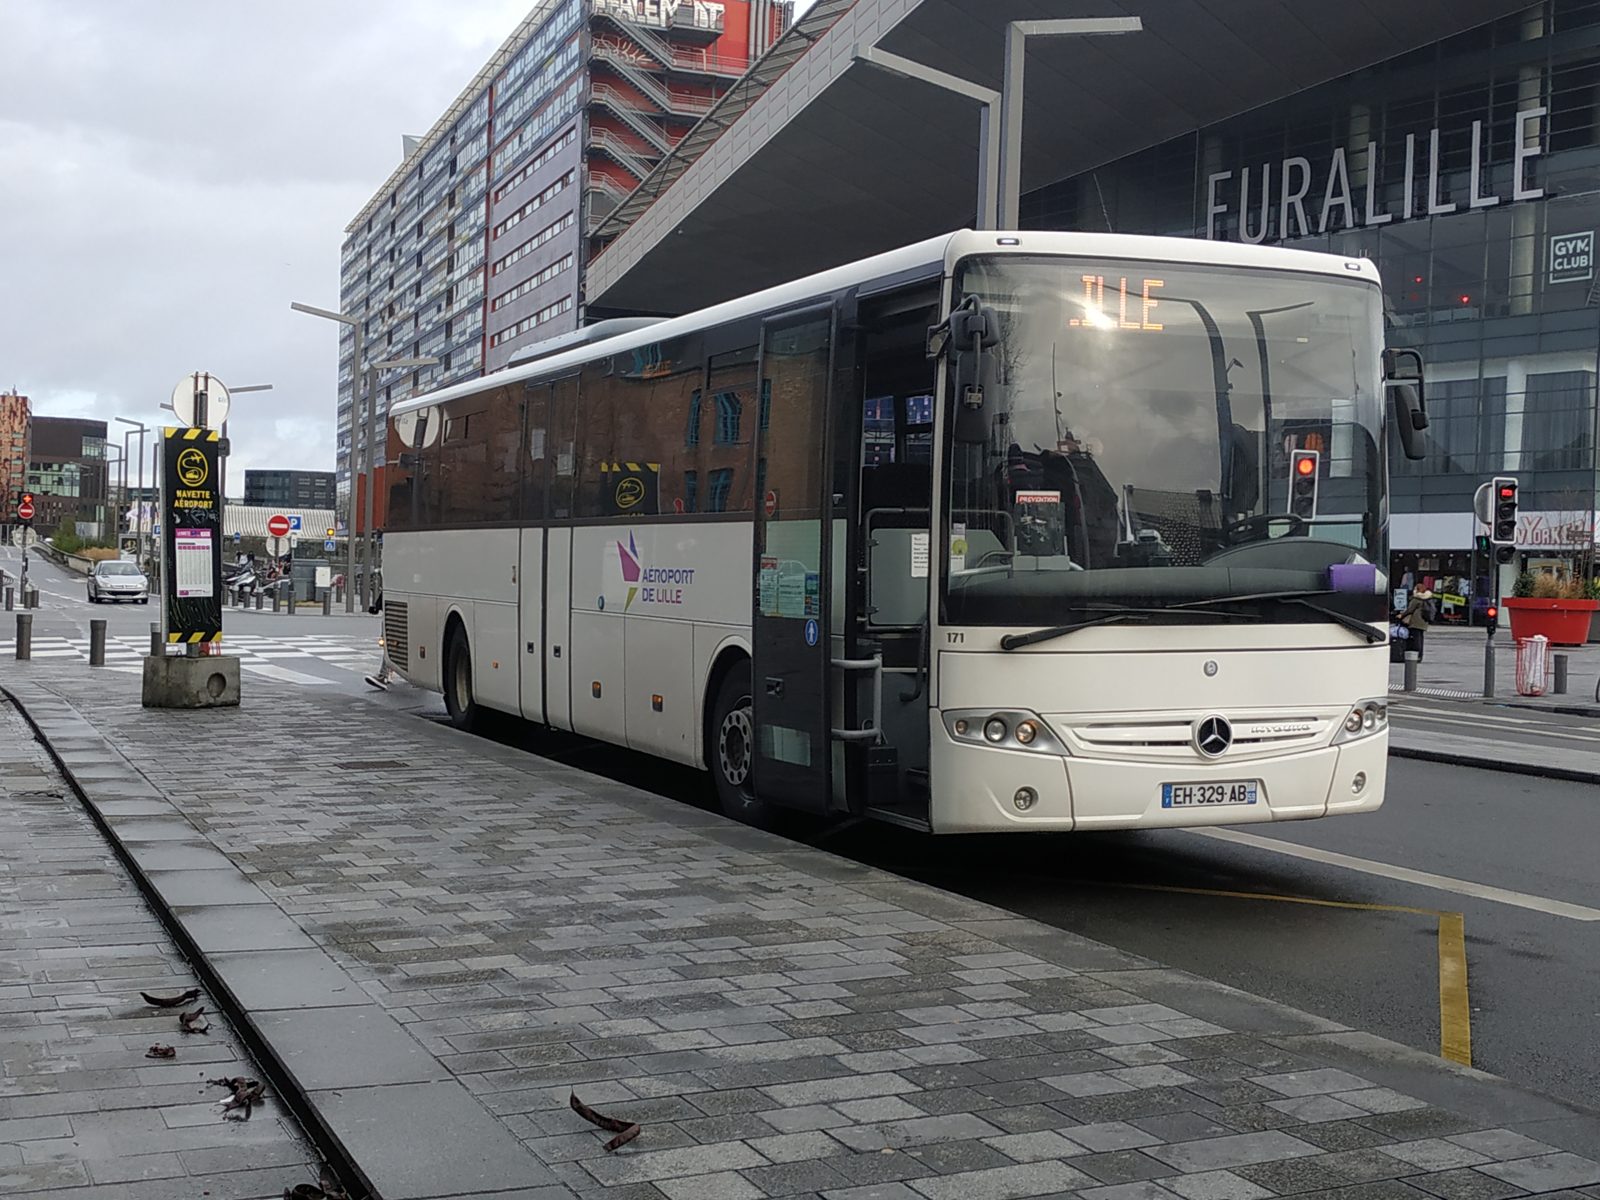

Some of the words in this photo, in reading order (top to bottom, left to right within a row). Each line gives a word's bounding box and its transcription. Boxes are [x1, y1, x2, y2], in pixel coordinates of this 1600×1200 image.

[1206, 106, 1547, 244] EURALILLE
[1554, 255, 1589, 270] CLUB
[176, 489, 211, 499] NAVETTE
[642, 587, 655, 602] DE
[656, 588, 682, 604] LILLE
[946, 633, 965, 643] 171
